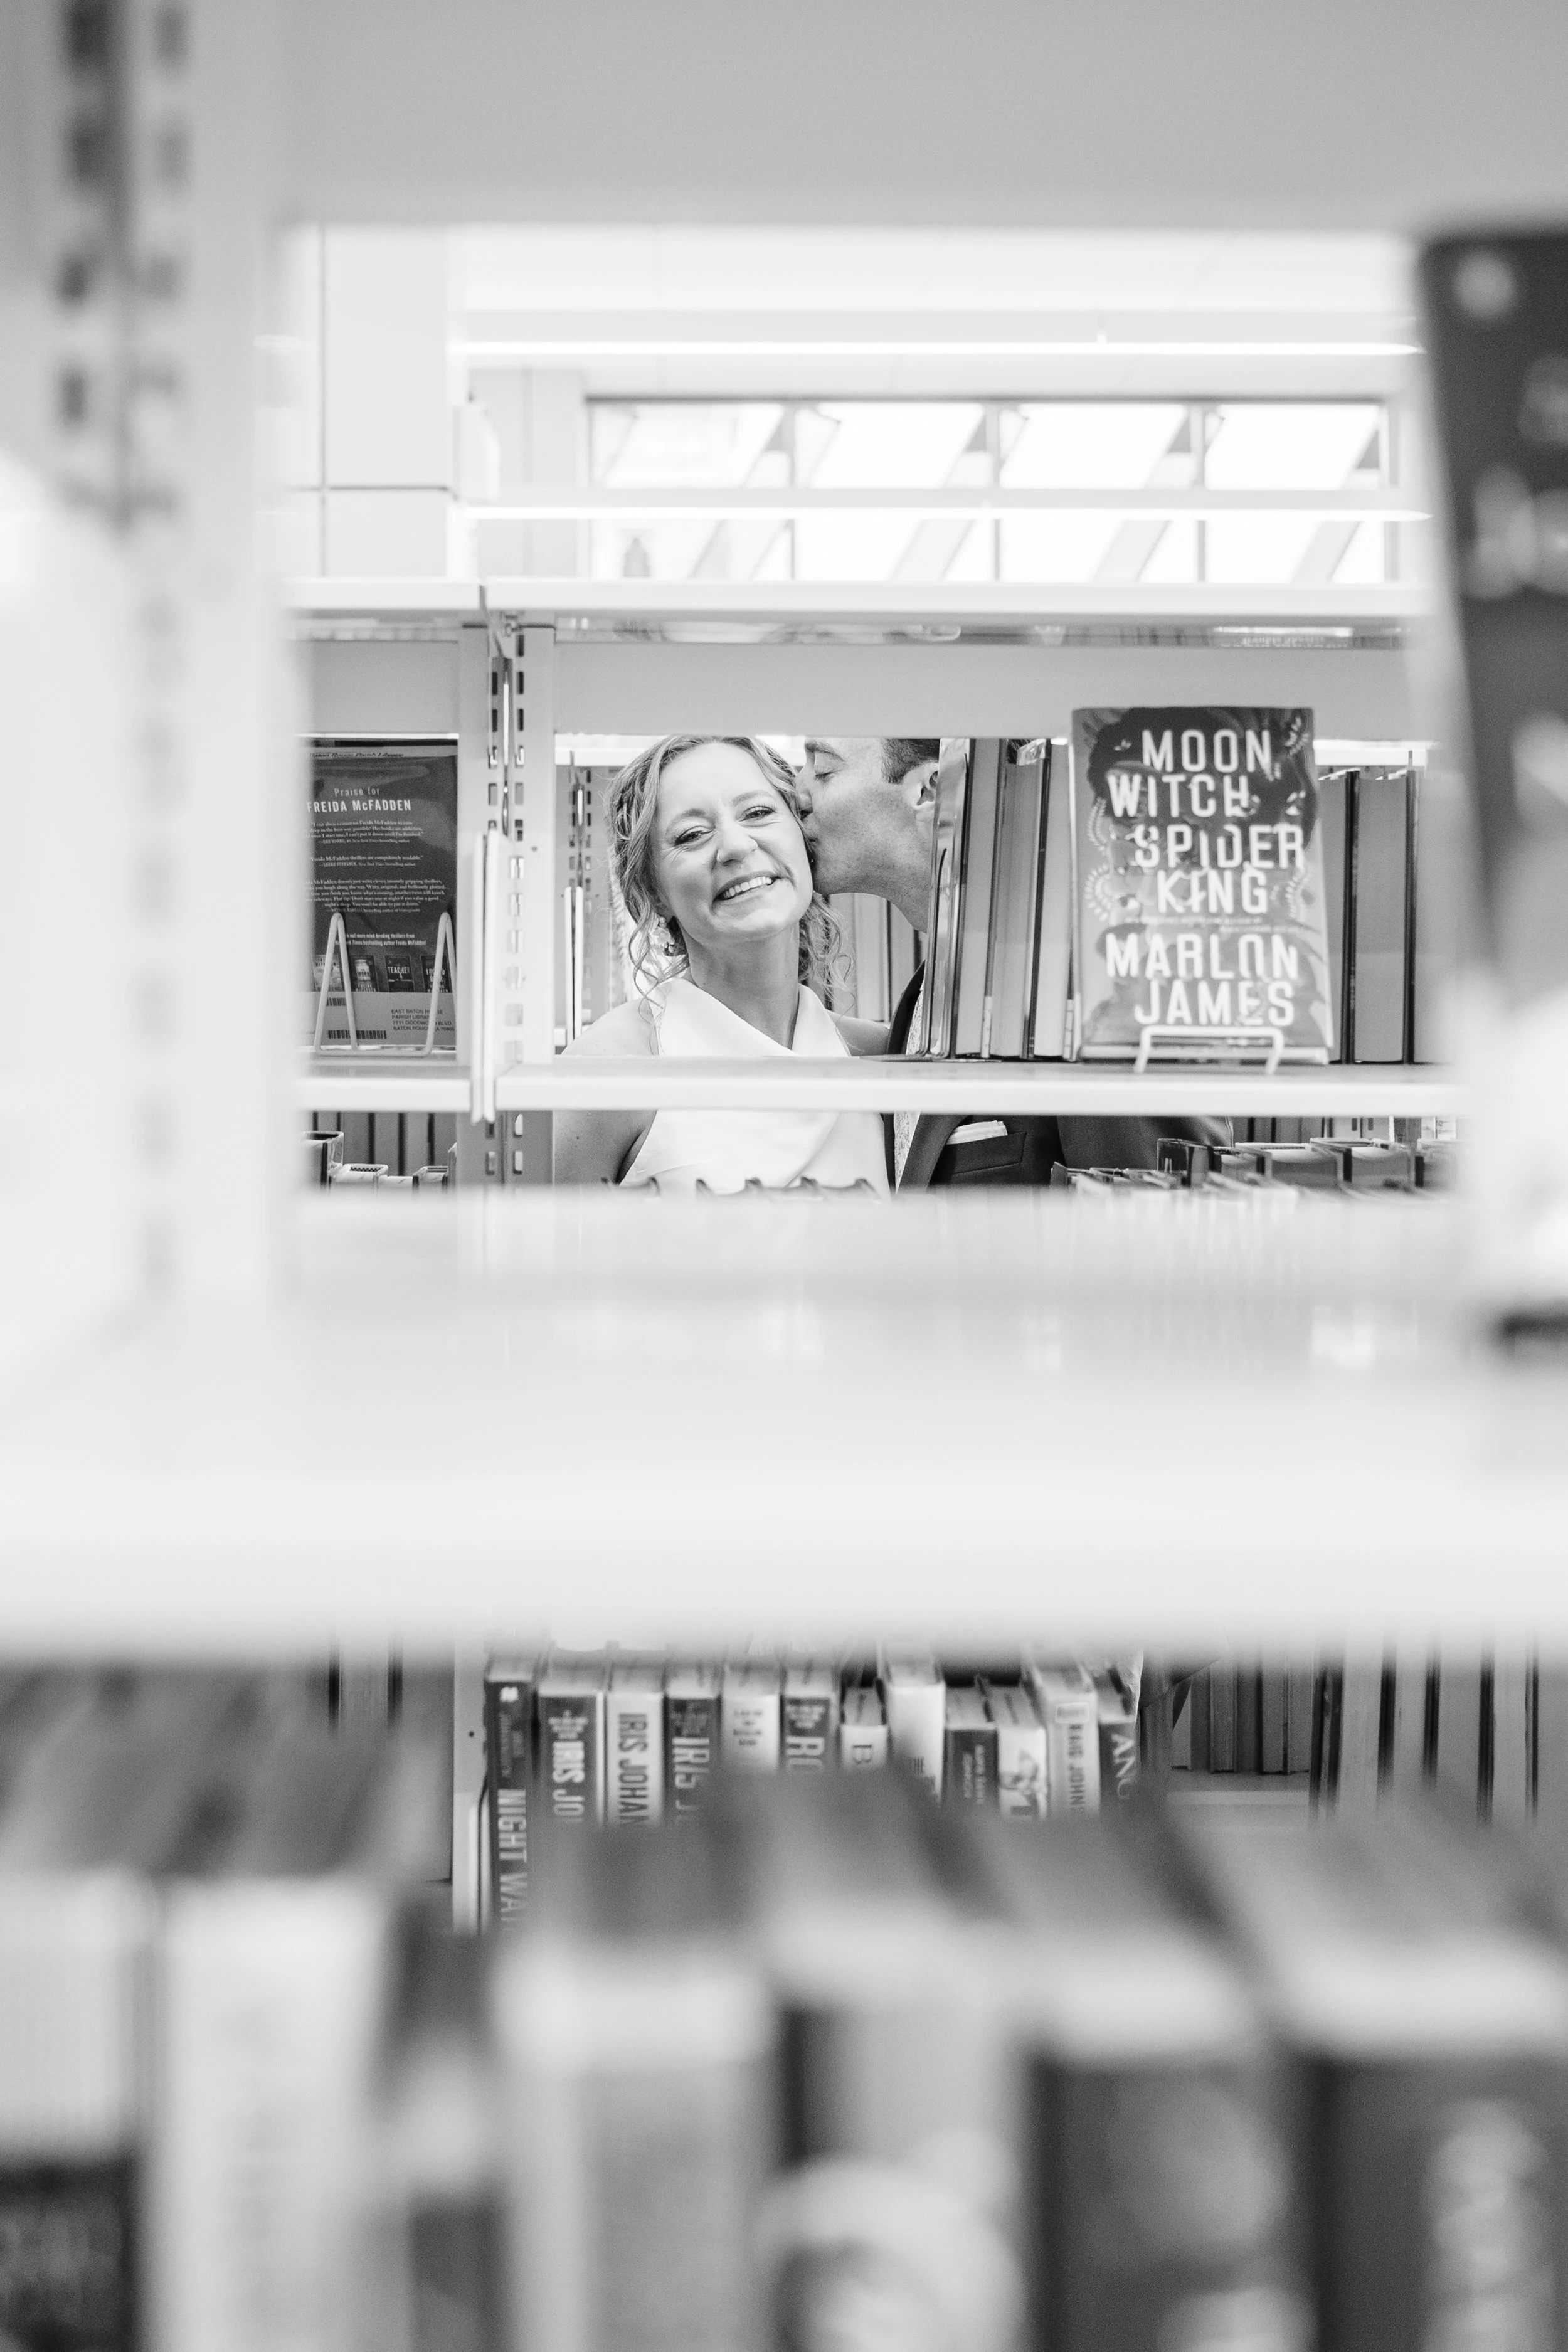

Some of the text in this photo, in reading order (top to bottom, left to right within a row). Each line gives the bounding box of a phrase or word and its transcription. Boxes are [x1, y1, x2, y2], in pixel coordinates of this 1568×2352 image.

[1142, 729, 1271, 774] MOON
[307, 799, 411, 813] FREIDA McFADDEN
[334, 786, 379, 797] Praise for
[1108, 773, 1251, 817] WITCH
[1134, 824, 1304, 869] SPIDER
[1157, 869, 1268, 914] KING
[1106, 933, 1299, 979] MARLON
[1134, 980, 1295, 1026] JAMES
[618, 1713, 648, 1752] IRIS
[498, 1789, 527, 1862] NIGHT
[552, 1789, 585, 1823] JO
